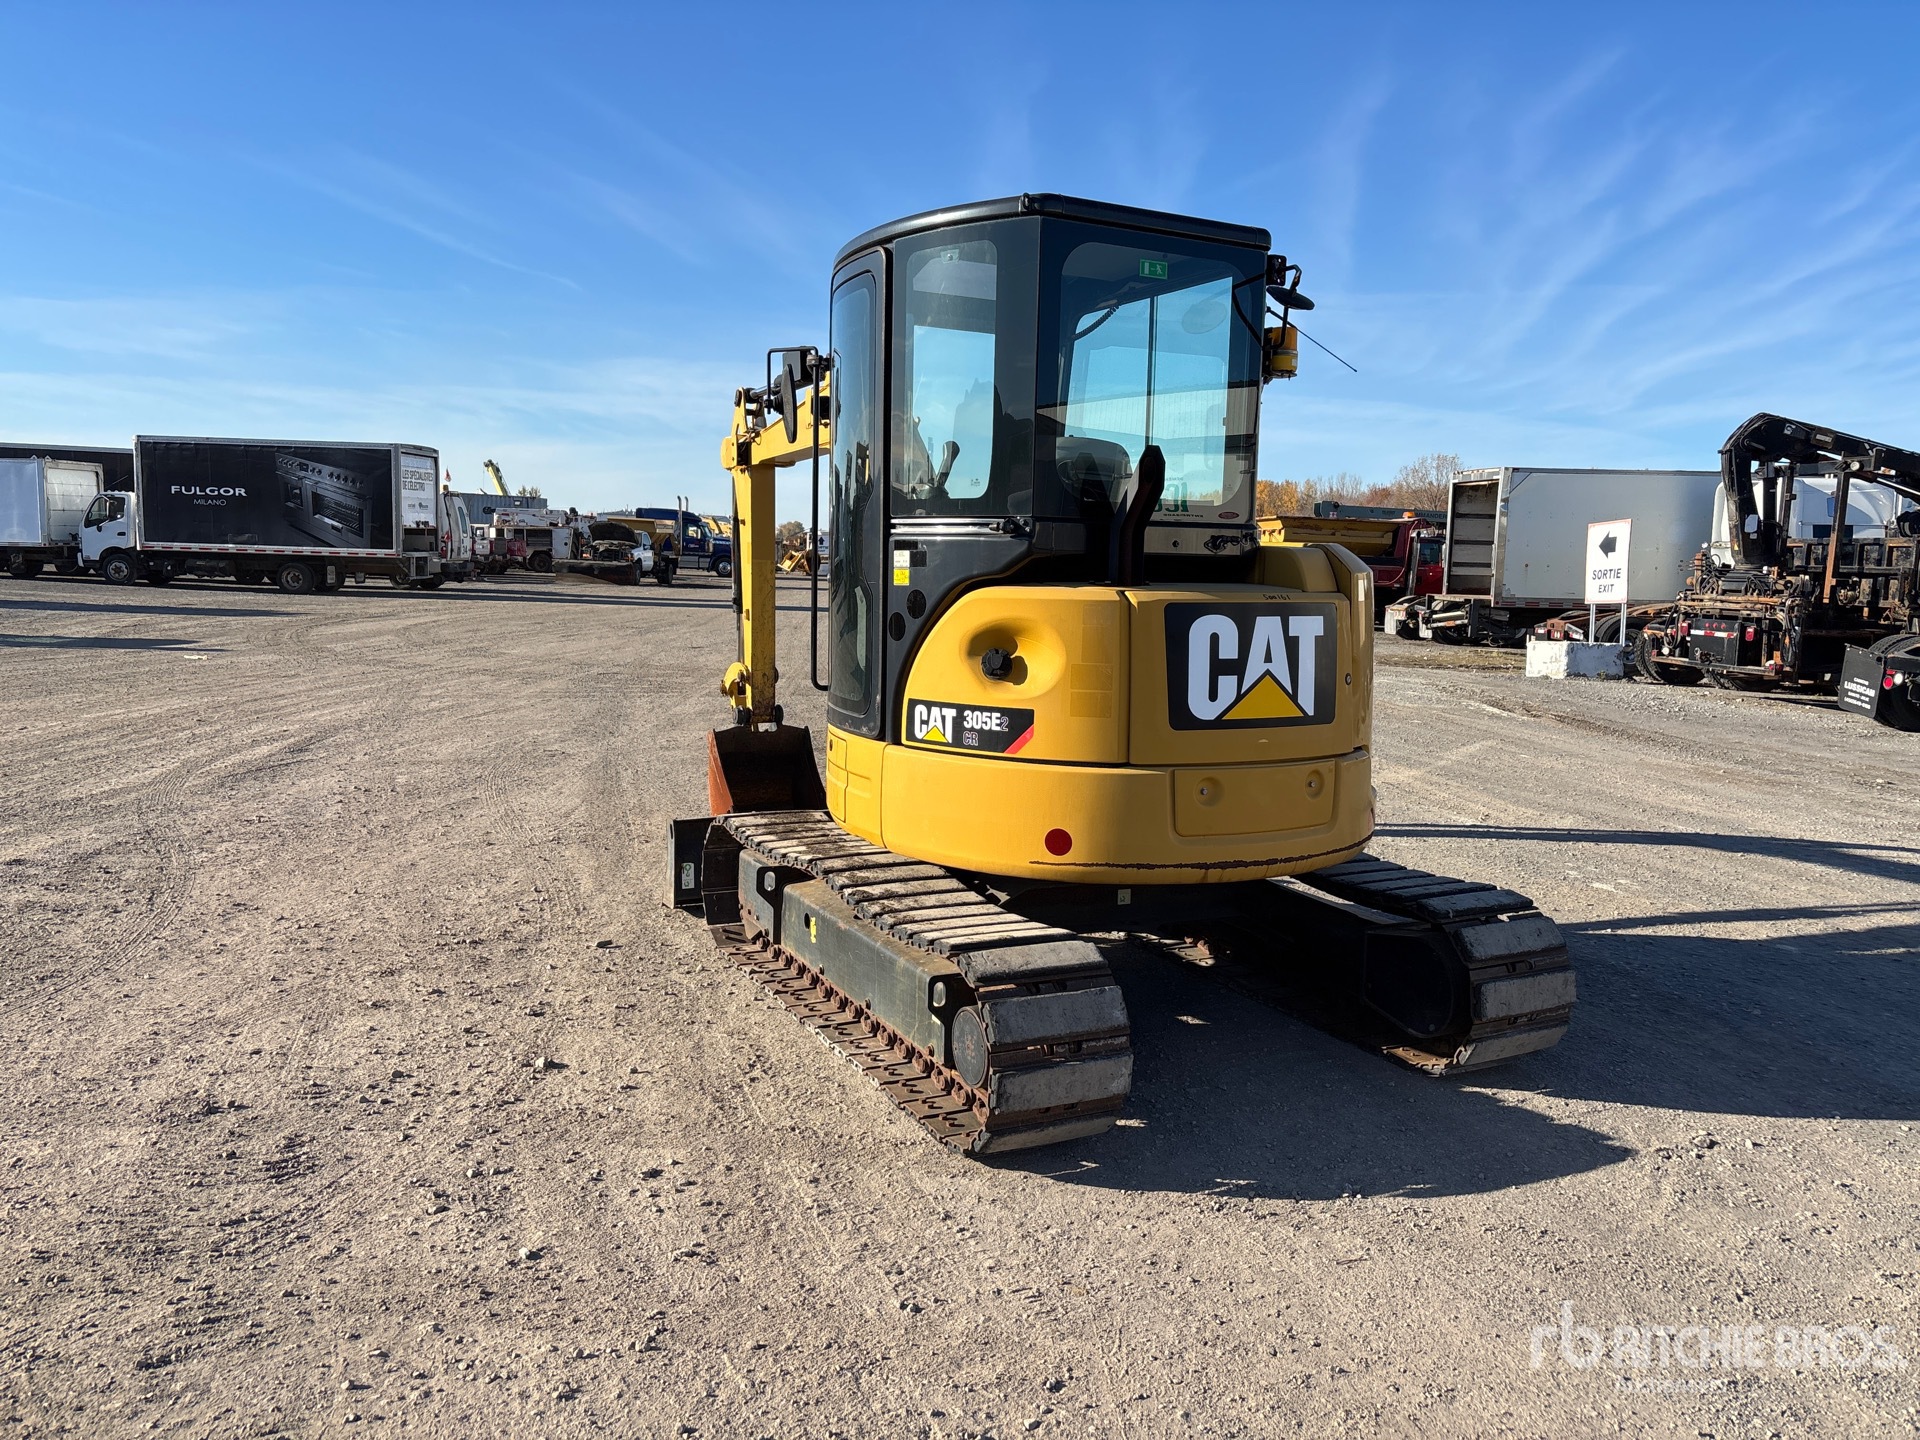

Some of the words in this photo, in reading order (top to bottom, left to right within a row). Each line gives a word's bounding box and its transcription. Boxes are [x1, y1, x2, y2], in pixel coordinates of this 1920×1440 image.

[171, 485, 247, 496] FULGOR
[1592, 568, 1622, 580] SORTIE
[1598, 584, 1614, 593] EXIT
[1188, 614, 1324, 720] CAT
[914, 704, 957, 743] CAT
[963, 710, 1009, 732] 305E2
[962, 731, 979, 746] CR
